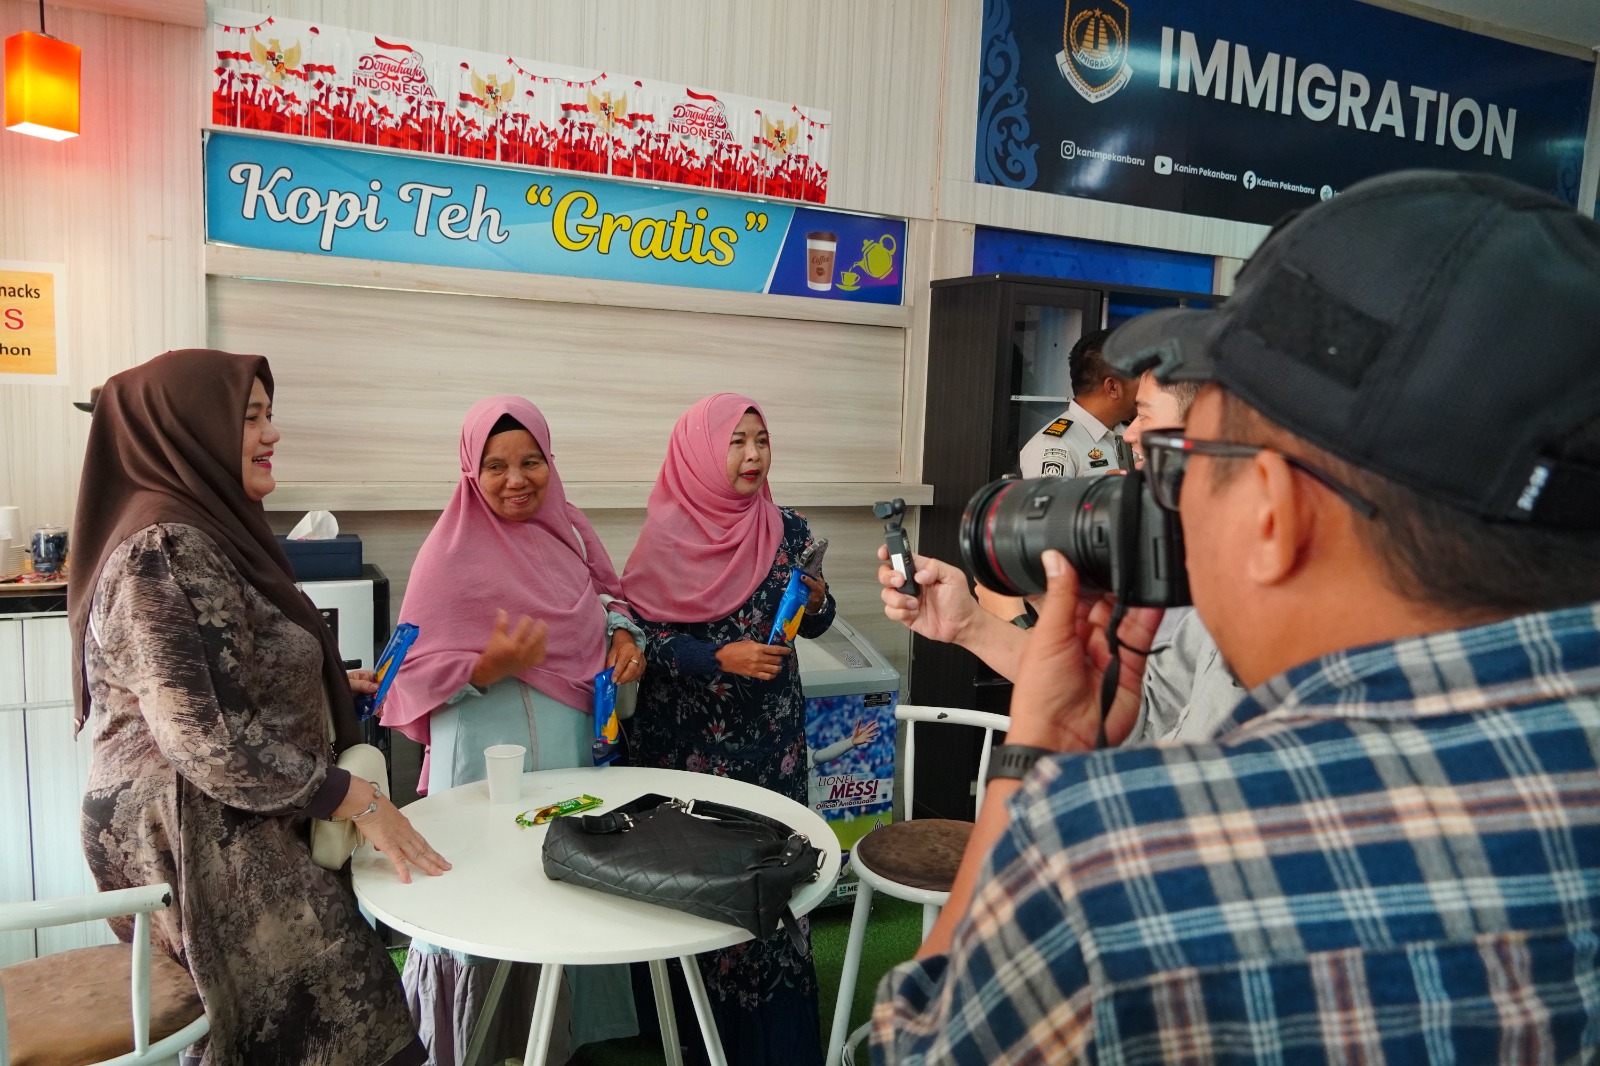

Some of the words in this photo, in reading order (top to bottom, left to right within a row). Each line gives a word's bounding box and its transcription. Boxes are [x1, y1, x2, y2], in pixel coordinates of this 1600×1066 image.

[358, 54, 425, 83] Dirgahayu
[1079, 53, 1112, 68] IMIGRASI
[353, 76, 434, 97] INDONESIA
[1159, 26, 1517, 160] IMMIGRATION
[668, 123, 733, 141] INDONESIA
[1077, 147, 1145, 166] kanimpekanbaru
[1174, 163, 1198, 175] Kanim
[1199, 167, 1237, 182] Pekanbaru
[1257, 177, 1279, 189] Kanim
[1280, 181, 1315, 195] Pekanbaru
[229, 163, 388, 251] Kopi
[399, 184, 510, 244] Teh
[818, 775, 856, 787] LIONEL
[829, 780, 879, 800] MESSI
[816, 801, 838, 811] Official
[838, 798, 877, 808] Ambassador
